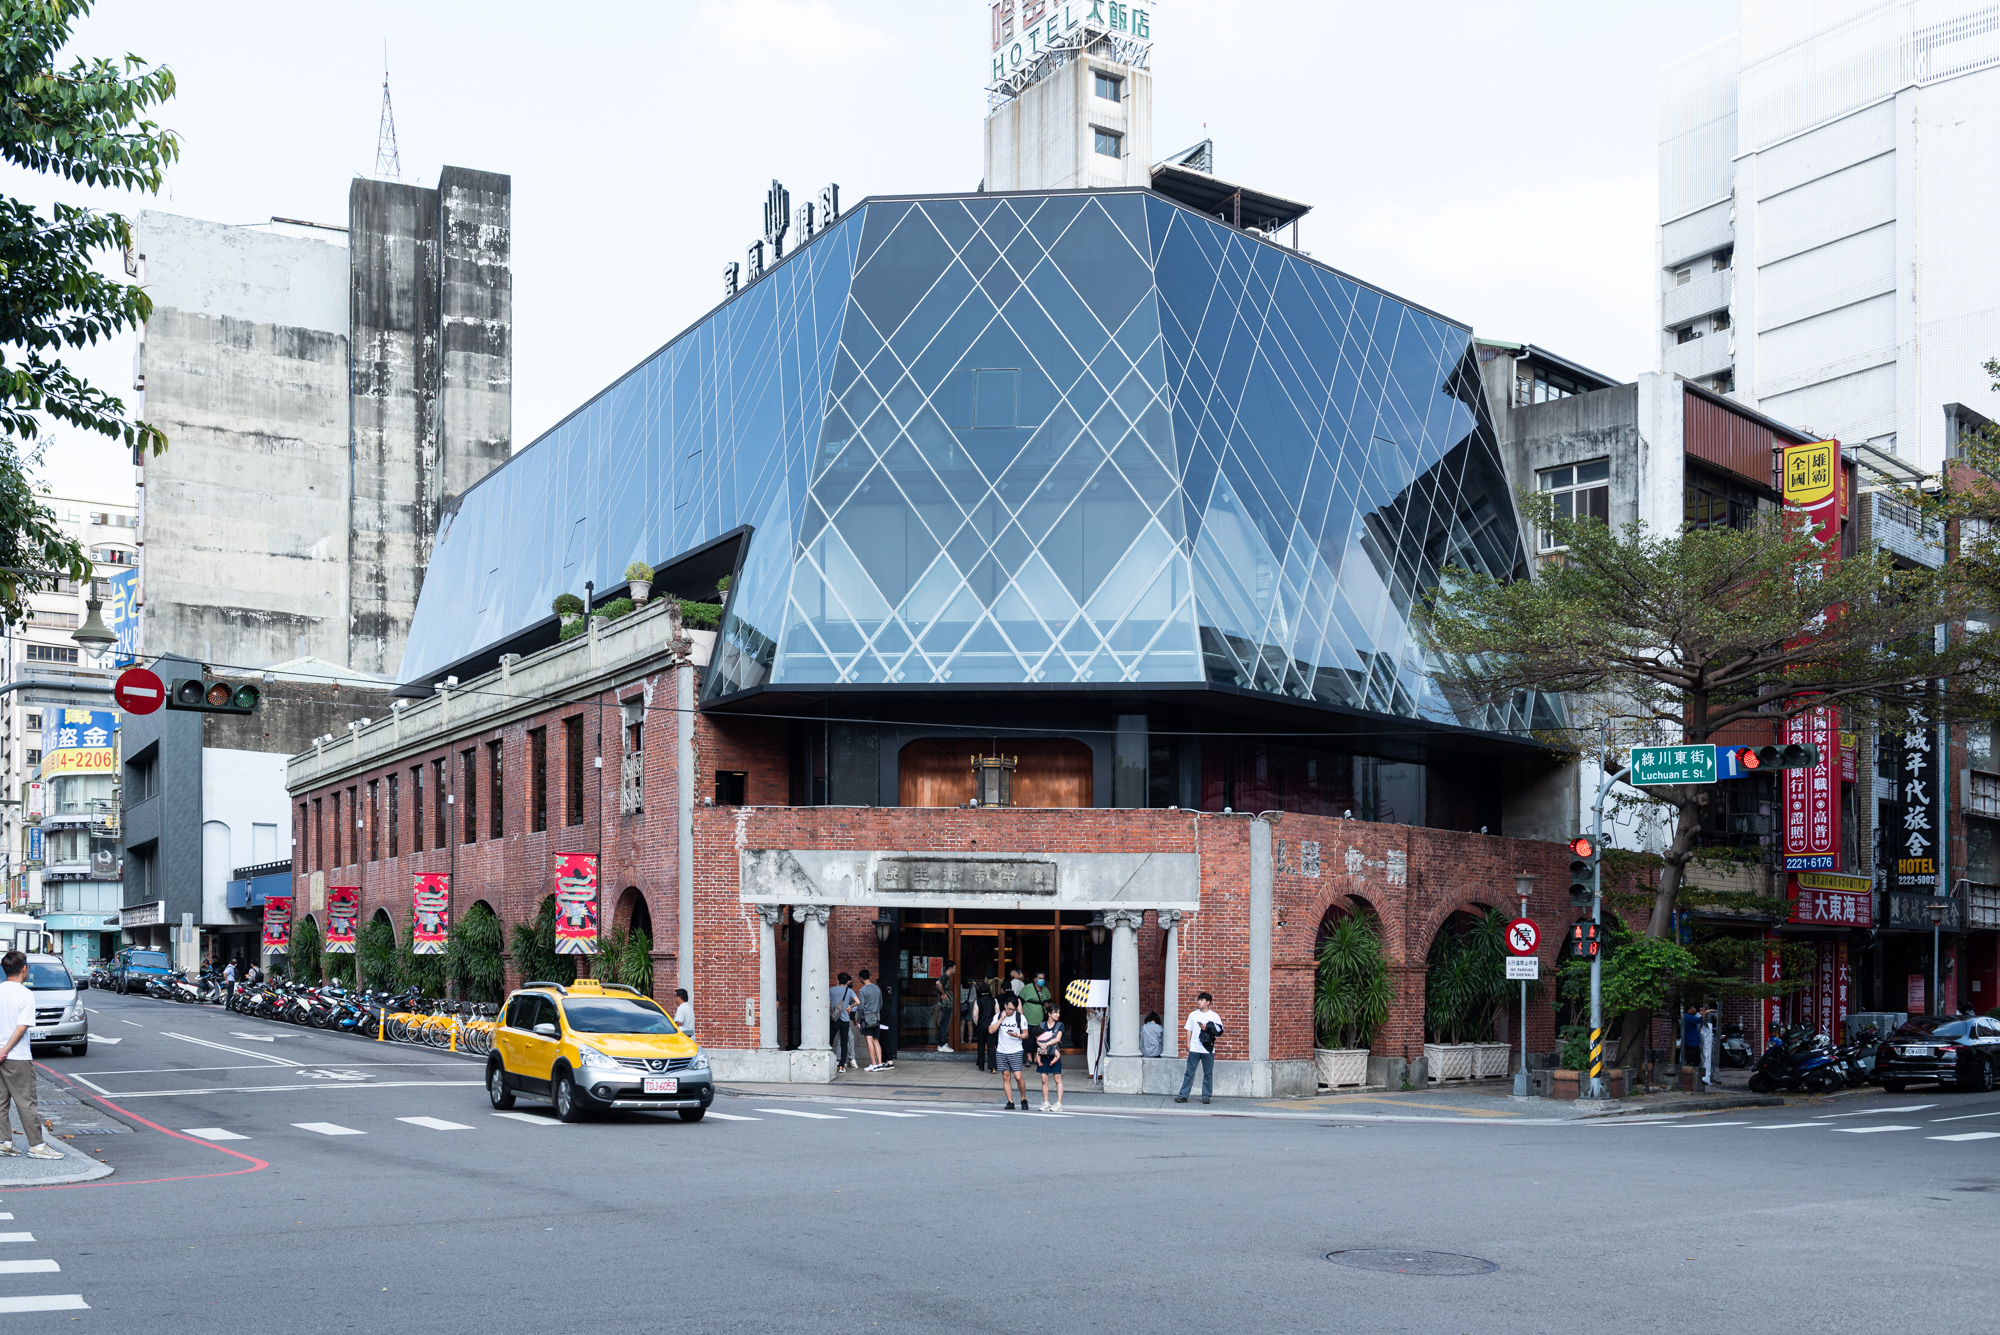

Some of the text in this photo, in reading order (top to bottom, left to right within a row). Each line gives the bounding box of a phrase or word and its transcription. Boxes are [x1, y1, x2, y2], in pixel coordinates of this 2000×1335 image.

[993, 6, 1080, 80] HOTEL
[1791, 457, 1805, 487] 全國
[1812, 453, 1827, 484] 雄霸
[1641, 750, 1705, 767] 綠川東街
[1641, 769, 1705, 780] Luchuan E. St.
[1898, 858, 1935, 874] HOTEL
[1898, 875, 1935, 886] 2222-5002
[1815, 892, 1856, 922] 大東海
[1900, 896, 1960, 927] 東城年旅舍
[71, 916, 95, 927] TOP
[1513, 928, 1532, 946] 停
[1839, 964, 1848, 1022] 大東海
